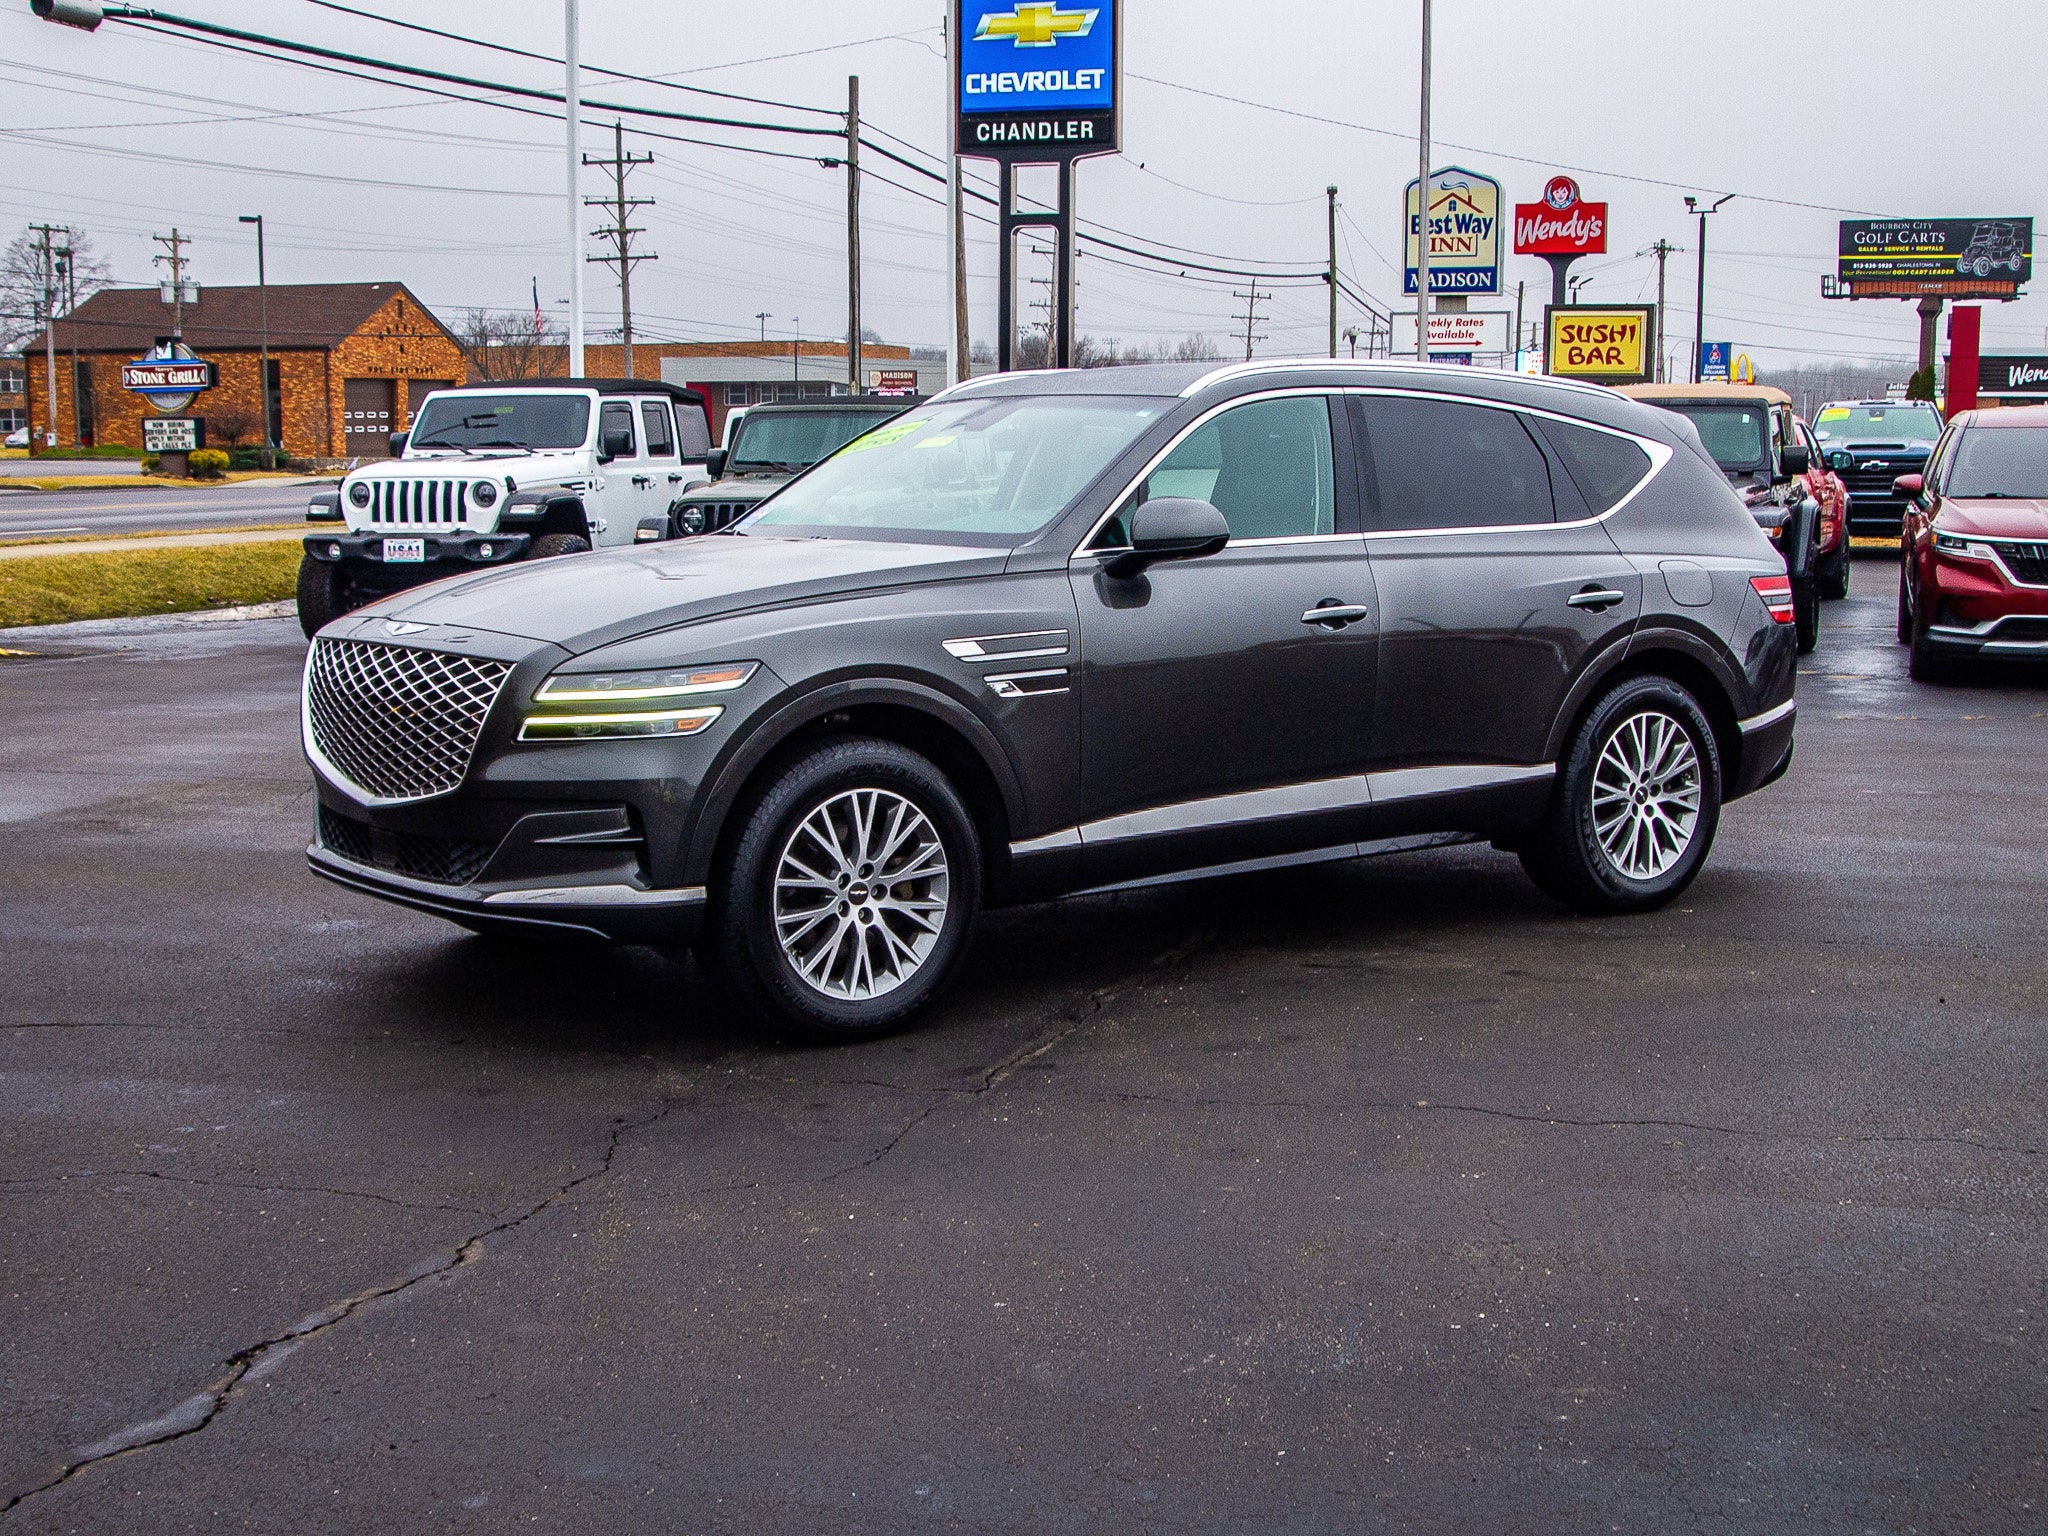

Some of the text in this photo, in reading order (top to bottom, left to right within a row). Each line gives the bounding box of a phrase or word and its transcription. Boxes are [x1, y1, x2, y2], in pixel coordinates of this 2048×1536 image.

[966, 68, 1105, 94] CHEVROLET
[976, 120, 1094, 141] CHANDLER
[1454, 213, 1494, 240] Way
[1517, 209, 1603, 247] Wendy's
[1870, 221, 1933, 230] BOURBON CITY
[1430, 236, 1474, 252] INN
[1854, 231, 1946, 244] GOLF CARTS
[1455, 318, 1485, 327] Rates
[1560, 324, 1637, 344] SUSHI
[1567, 346, 1625, 366] BAR
[130, 369, 201, 385] STONE GRILL
[882, 371, 913, 379] MADISON
